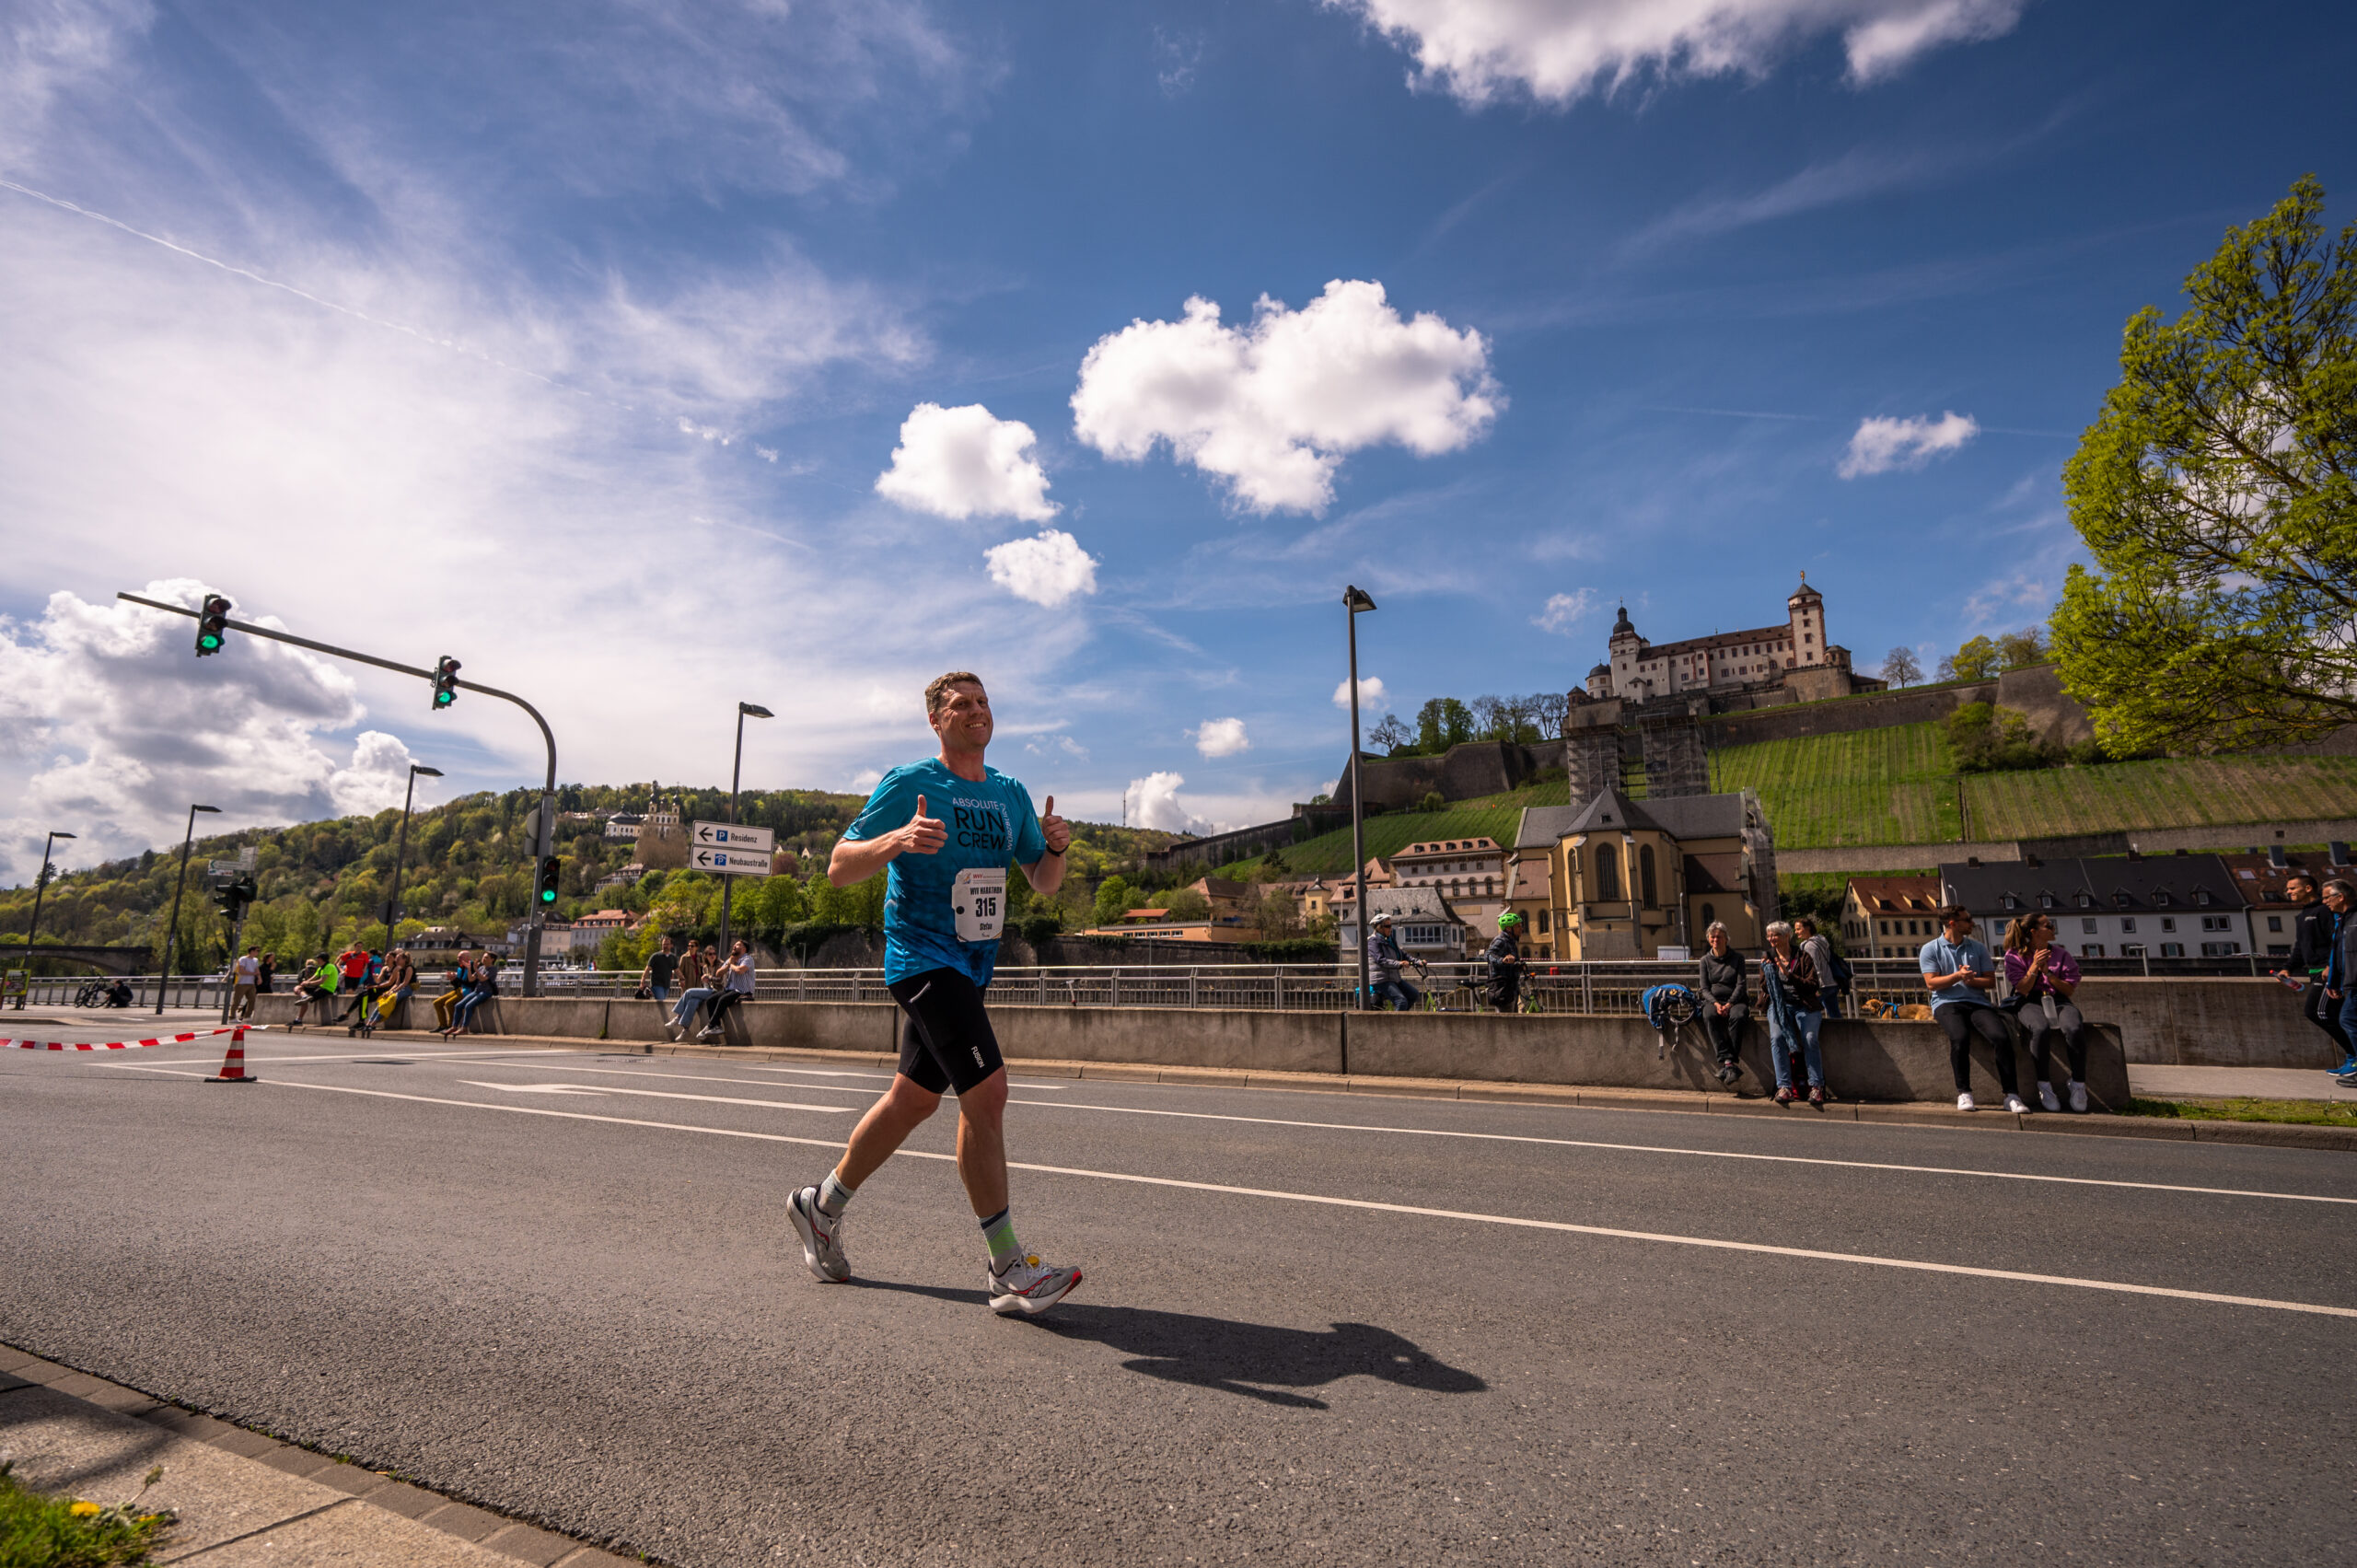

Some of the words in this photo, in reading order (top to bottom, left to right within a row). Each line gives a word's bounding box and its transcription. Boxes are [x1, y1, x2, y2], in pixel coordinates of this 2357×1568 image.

[952, 797, 999, 810] ABSOLUTE
[953, 807, 1005, 832] RUN
[731, 833, 757, 843] Residenz
[958, 830, 1006, 850] CREW
[729, 857, 767, 867] Neubaustraße
[980, 886, 1002, 894] MARATHON
[975, 897, 996, 917] 315
[970, 1045, 985, 1068] FUSION
